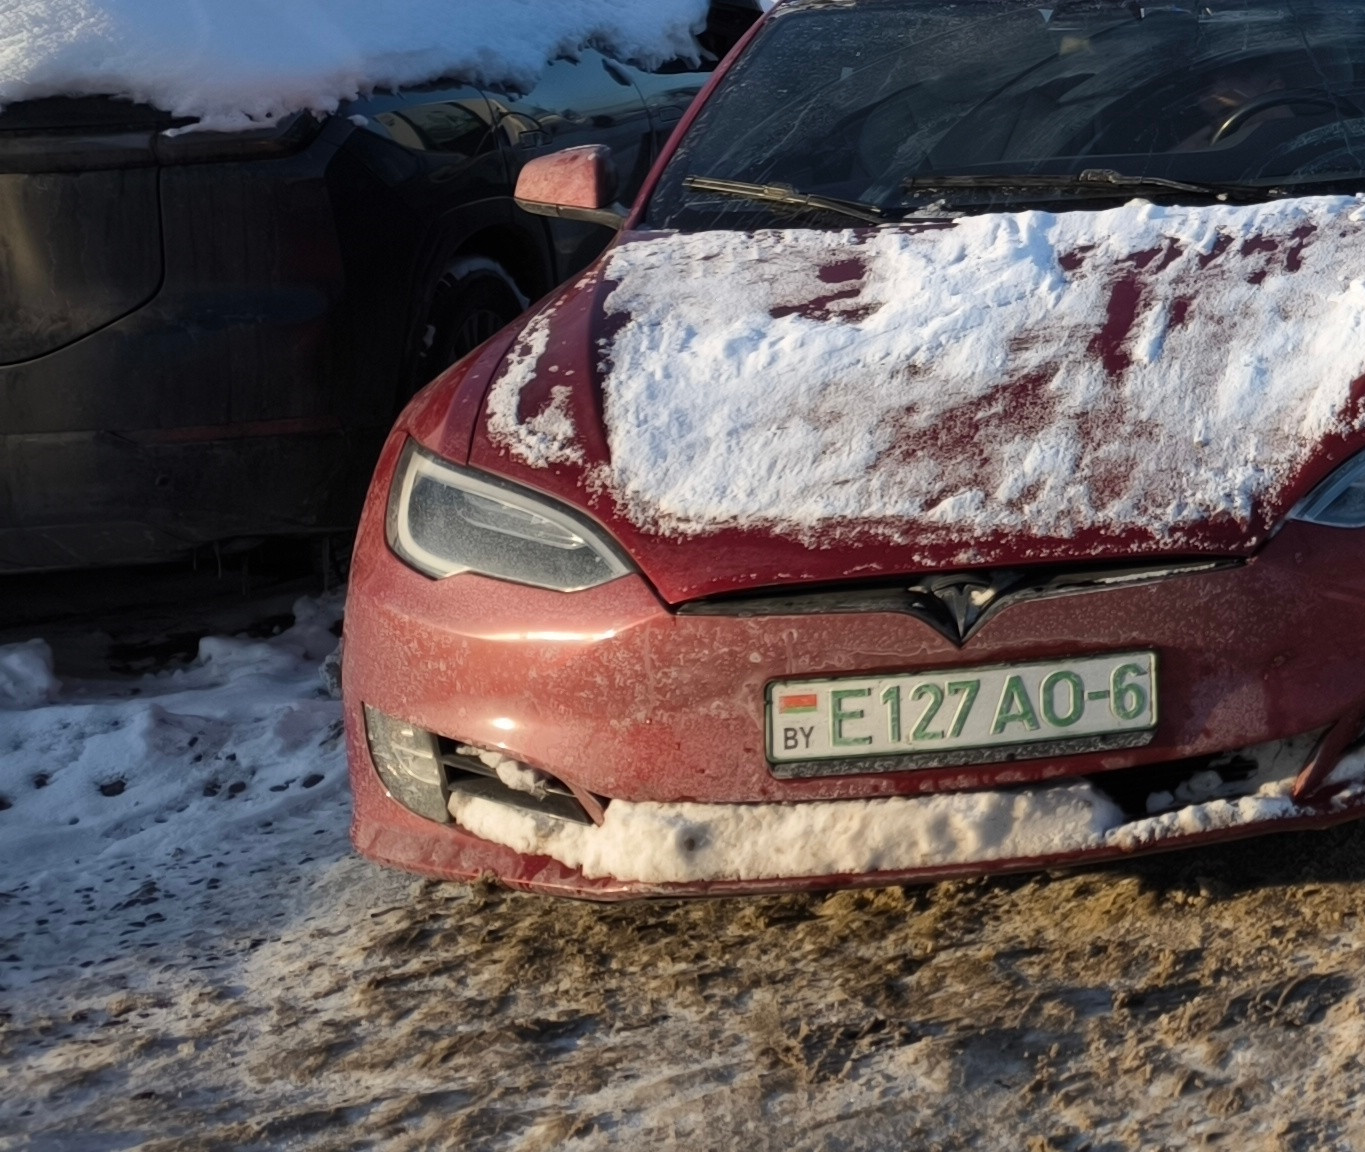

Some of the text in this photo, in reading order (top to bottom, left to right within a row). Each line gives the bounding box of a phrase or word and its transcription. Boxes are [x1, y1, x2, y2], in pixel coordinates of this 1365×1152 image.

[828, 662, 1148, 747] E127 AO-6
[783, 726, 815, 750] BY
